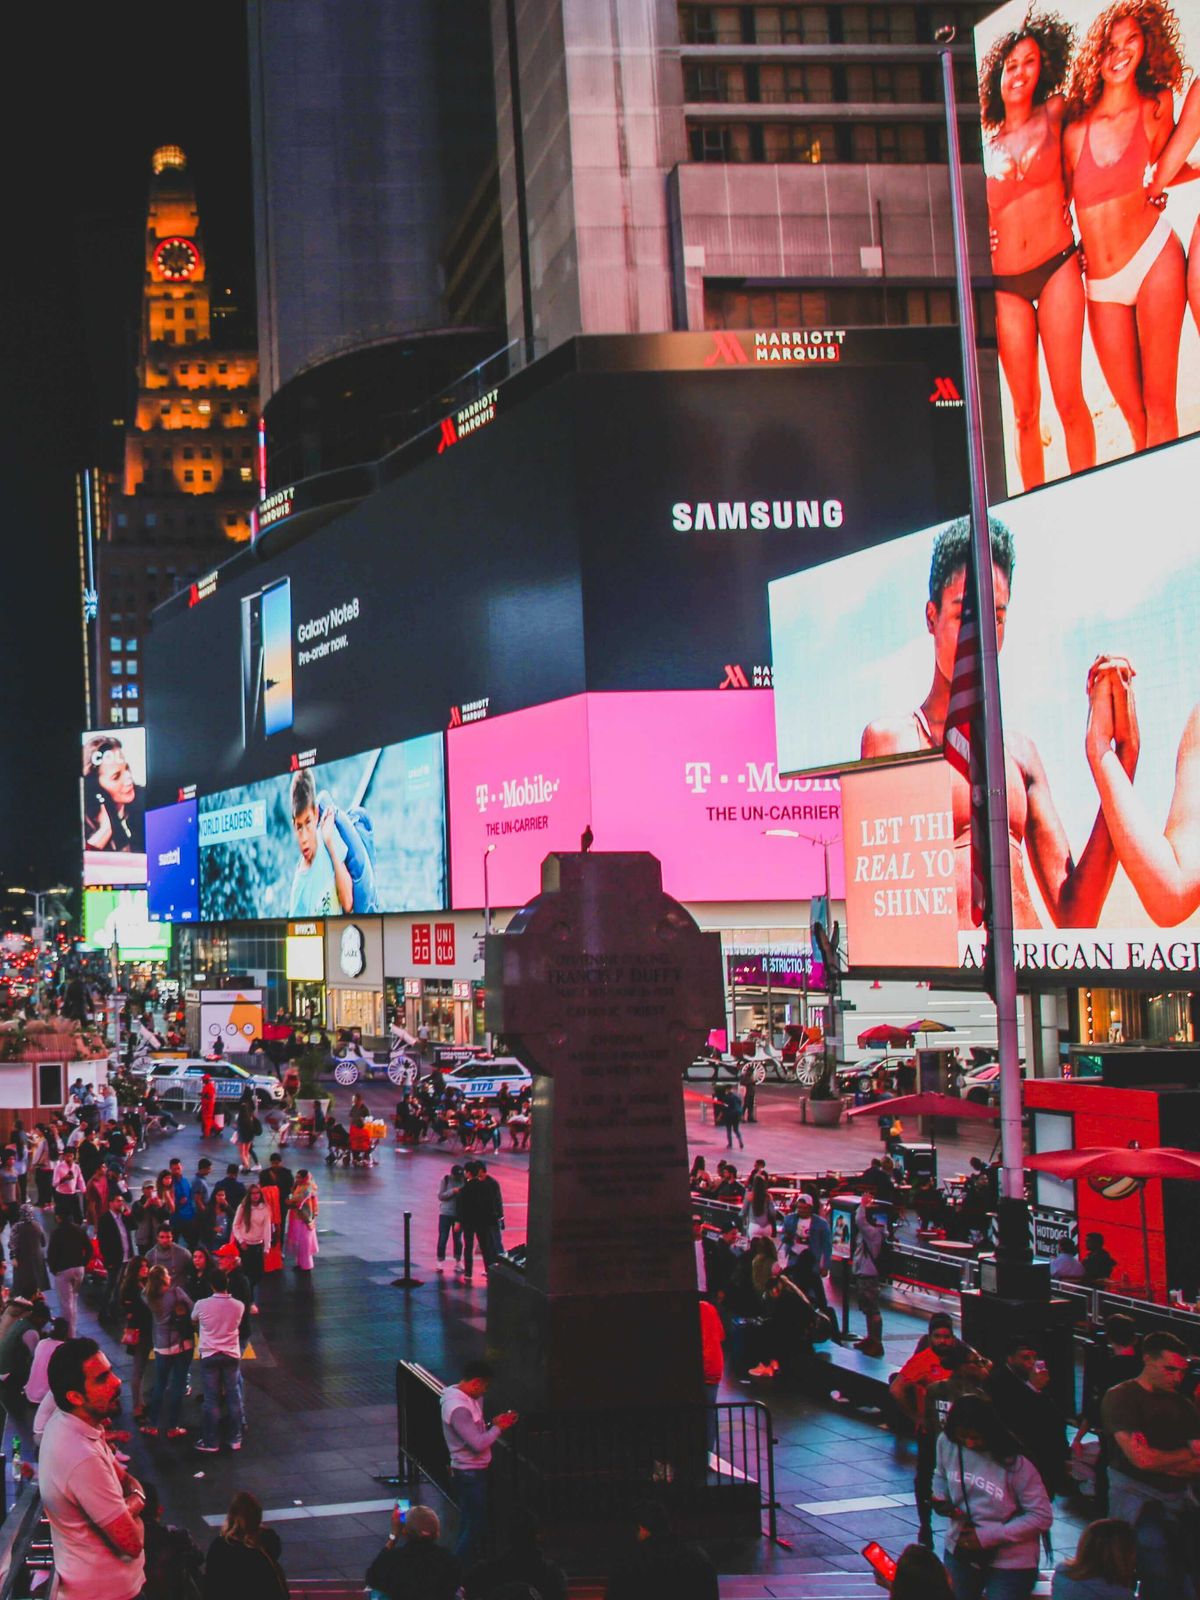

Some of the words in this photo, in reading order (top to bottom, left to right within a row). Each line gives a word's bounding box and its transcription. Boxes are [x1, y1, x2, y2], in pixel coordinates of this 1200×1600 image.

[755, 331, 846, 345] MARRIOTT
[757, 347, 836, 361] MARQUIS
[457, 389, 499, 424] MARRIOTT
[458, 406, 495, 438] MARQUIS
[672, 500, 843, 531] SAMSUNG
[298, 614, 330, 643] Galaxy
[329, 598, 360, 630] Note8
[298, 641, 330, 667] Pre-order
[330, 634, 349, 653] now.
[221, 809, 253, 833] LEADERS
[486, 822, 500, 837] THE
[501, 815, 549, 834] UN-CARRIER
[705, 806, 737, 821] THE
[741, 805, 840, 821] UN-CARRIER
[860, 817, 903, 847] LET
[854, 852, 915, 882] REAL
[436, 928, 453, 943] UNI
[436, 946, 453, 963] QLO
[960, 942, 1114, 970] ARICAN
[471, 1082, 494, 1092] NYPD
